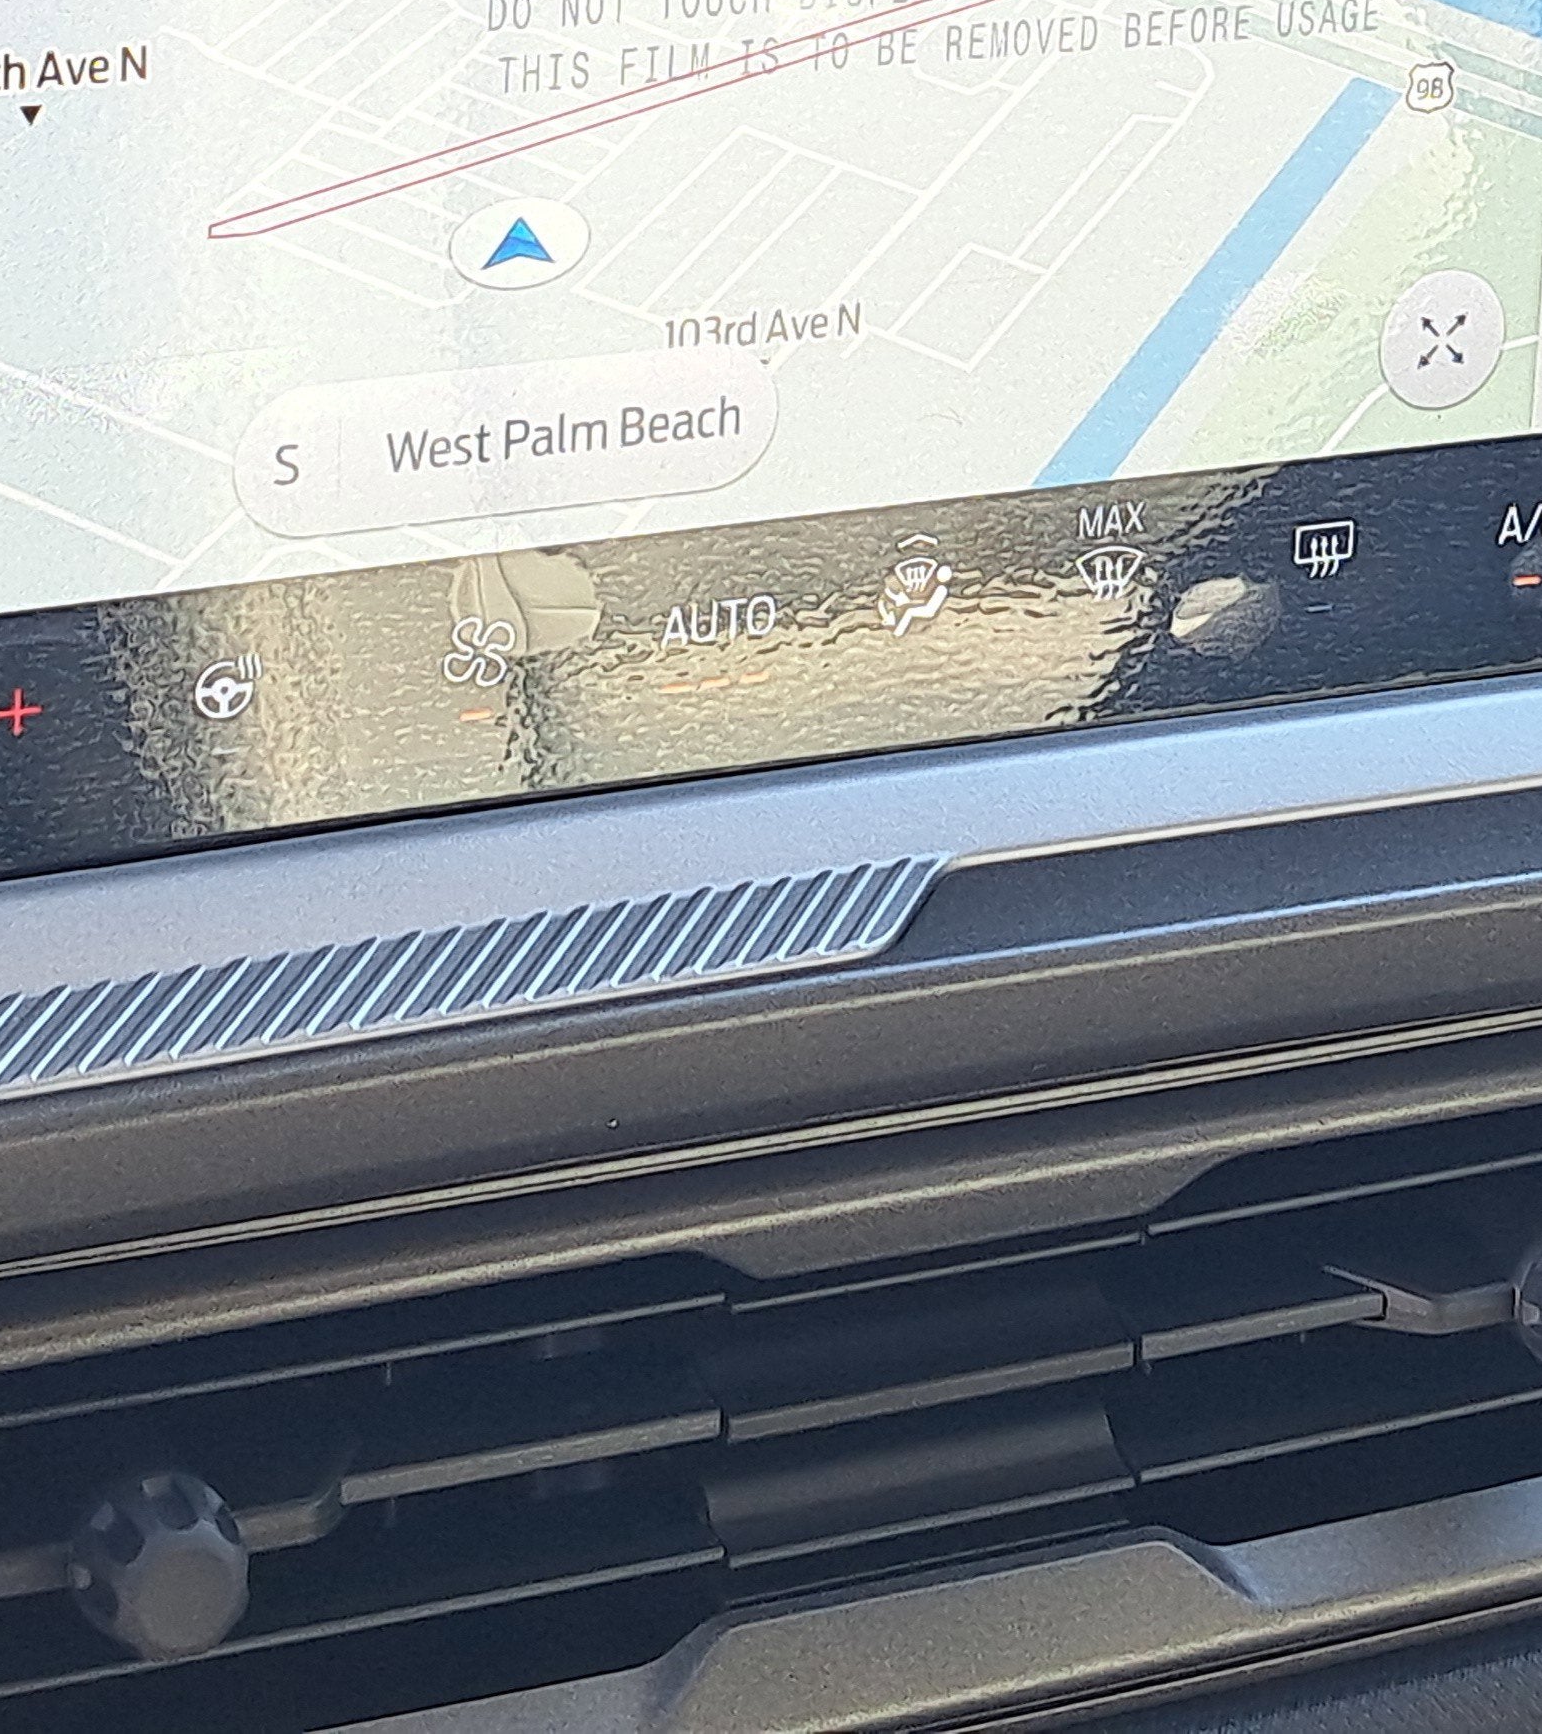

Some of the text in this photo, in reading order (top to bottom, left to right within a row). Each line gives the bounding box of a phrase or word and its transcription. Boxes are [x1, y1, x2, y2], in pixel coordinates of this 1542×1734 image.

[36, 50, 111, 88] Ave
[120, 46, 148, 82] N
[499, 51, 590, 94] THIS
[621, 42, 711, 86] FILM
[742, 36, 780, 76] IS
[813, 31, 851, 73] TO
[877, 28, 920, 67] BE
[946, 15, 1098, 62] REMOVED
[1124, 4, 1252, 49] BEFORE
[1416, 76, 1444, 100] 98
[765, 309, 828, 343] Ave
[837, 302, 860, 336] N
[386, 396, 741, 472] West Palm Beach
[273, 443, 301, 485] S
[1077, 503, 1146, 537] MAX
[660, 597, 776, 644] AUTO
